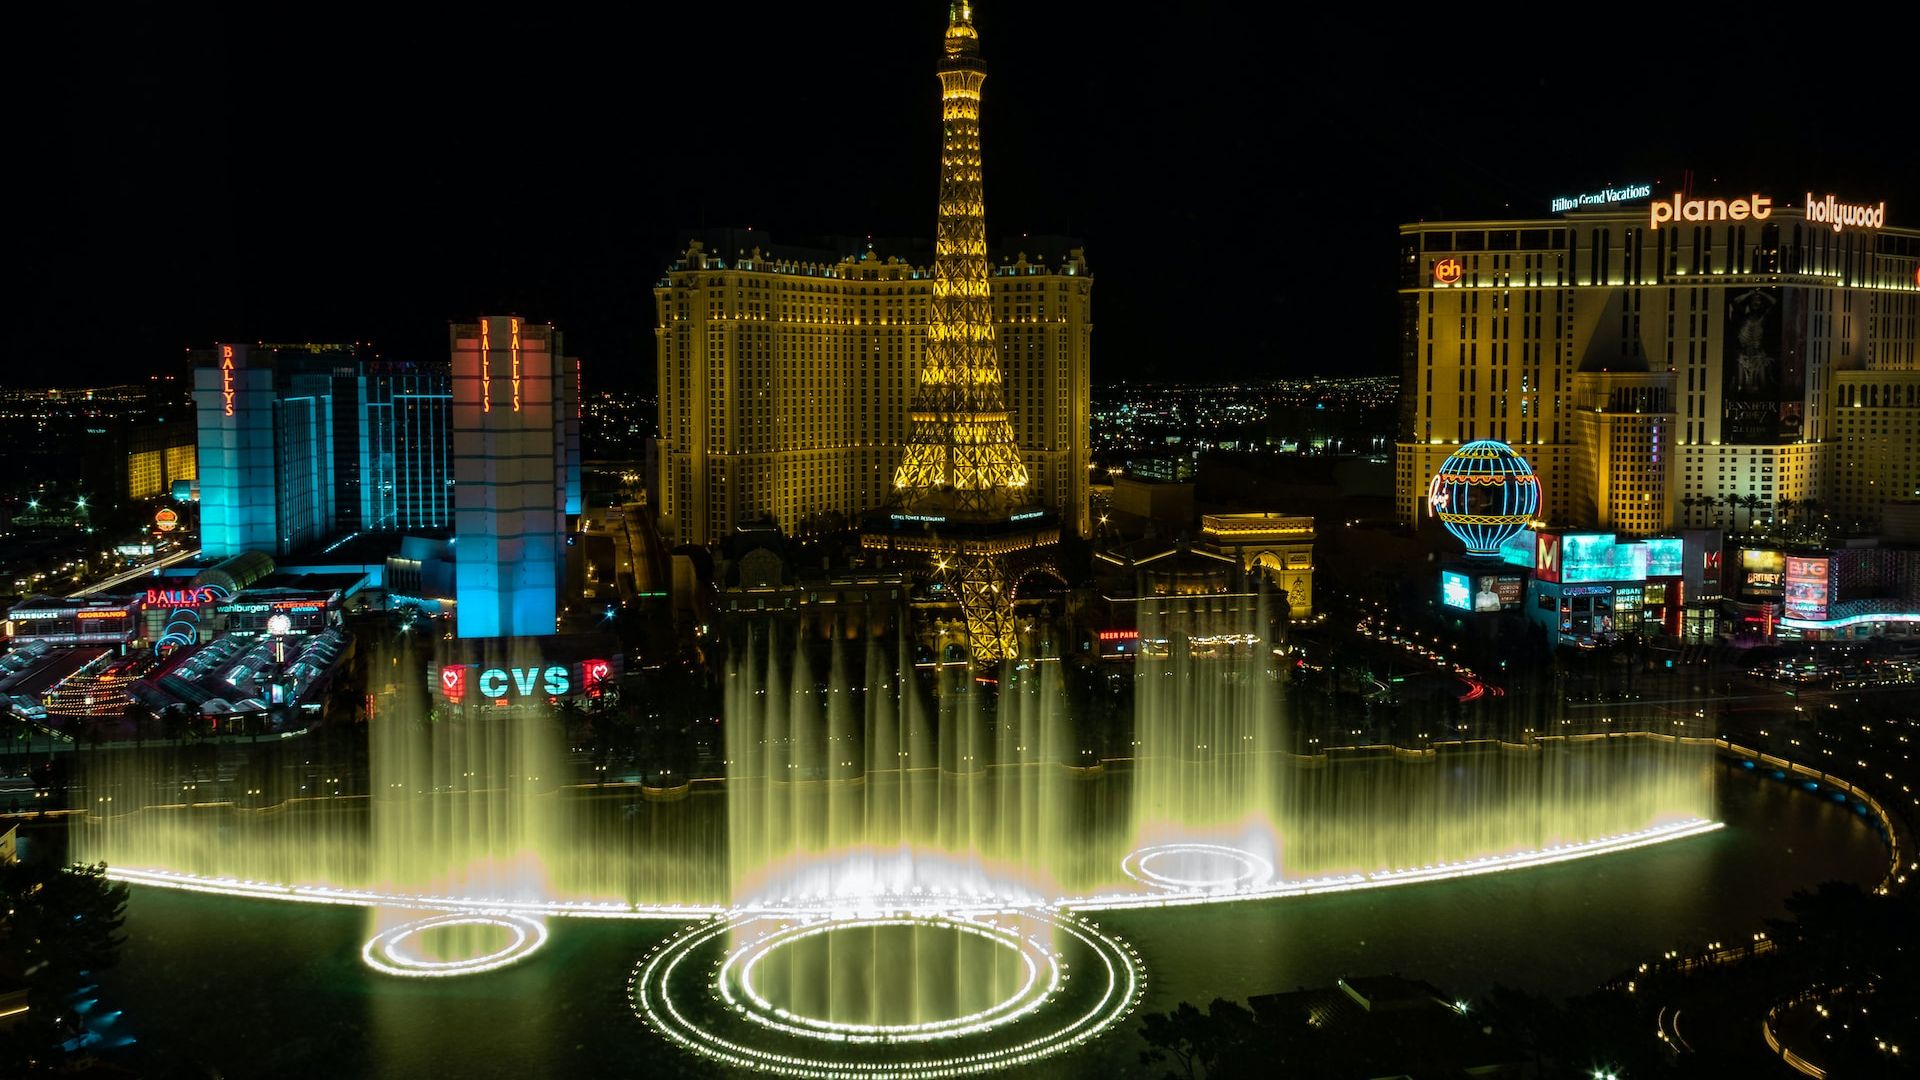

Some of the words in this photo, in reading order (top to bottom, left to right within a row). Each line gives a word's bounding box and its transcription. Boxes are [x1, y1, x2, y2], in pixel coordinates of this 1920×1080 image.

[1552, 198, 1578, 212] Hilton
[1579, 190, 1605, 204] Grand
[1606, 185, 1650, 202] Vacations
[1650, 193, 1772, 230] planet
[1806, 192, 1884, 232] hollywood
[1439, 259, 1461, 279] ph
[1538, 537, 1557, 572] M
[1789, 561, 1826, 578] BIG
[1747, 572, 1780, 585] BRITNEY
[147, 587, 214, 604] BALLY'S
[1616, 588, 1640, 596] URBAN
[1616, 595, 1641, 603] OUTFIT
[9, 612, 58, 620] STARBUCKS
[217, 603, 270, 613] wahlburgers
[1100, 632, 1119, 640] BEER
[1119, 631, 1139, 639] PARK
[479, 666, 569, 698] CVS
